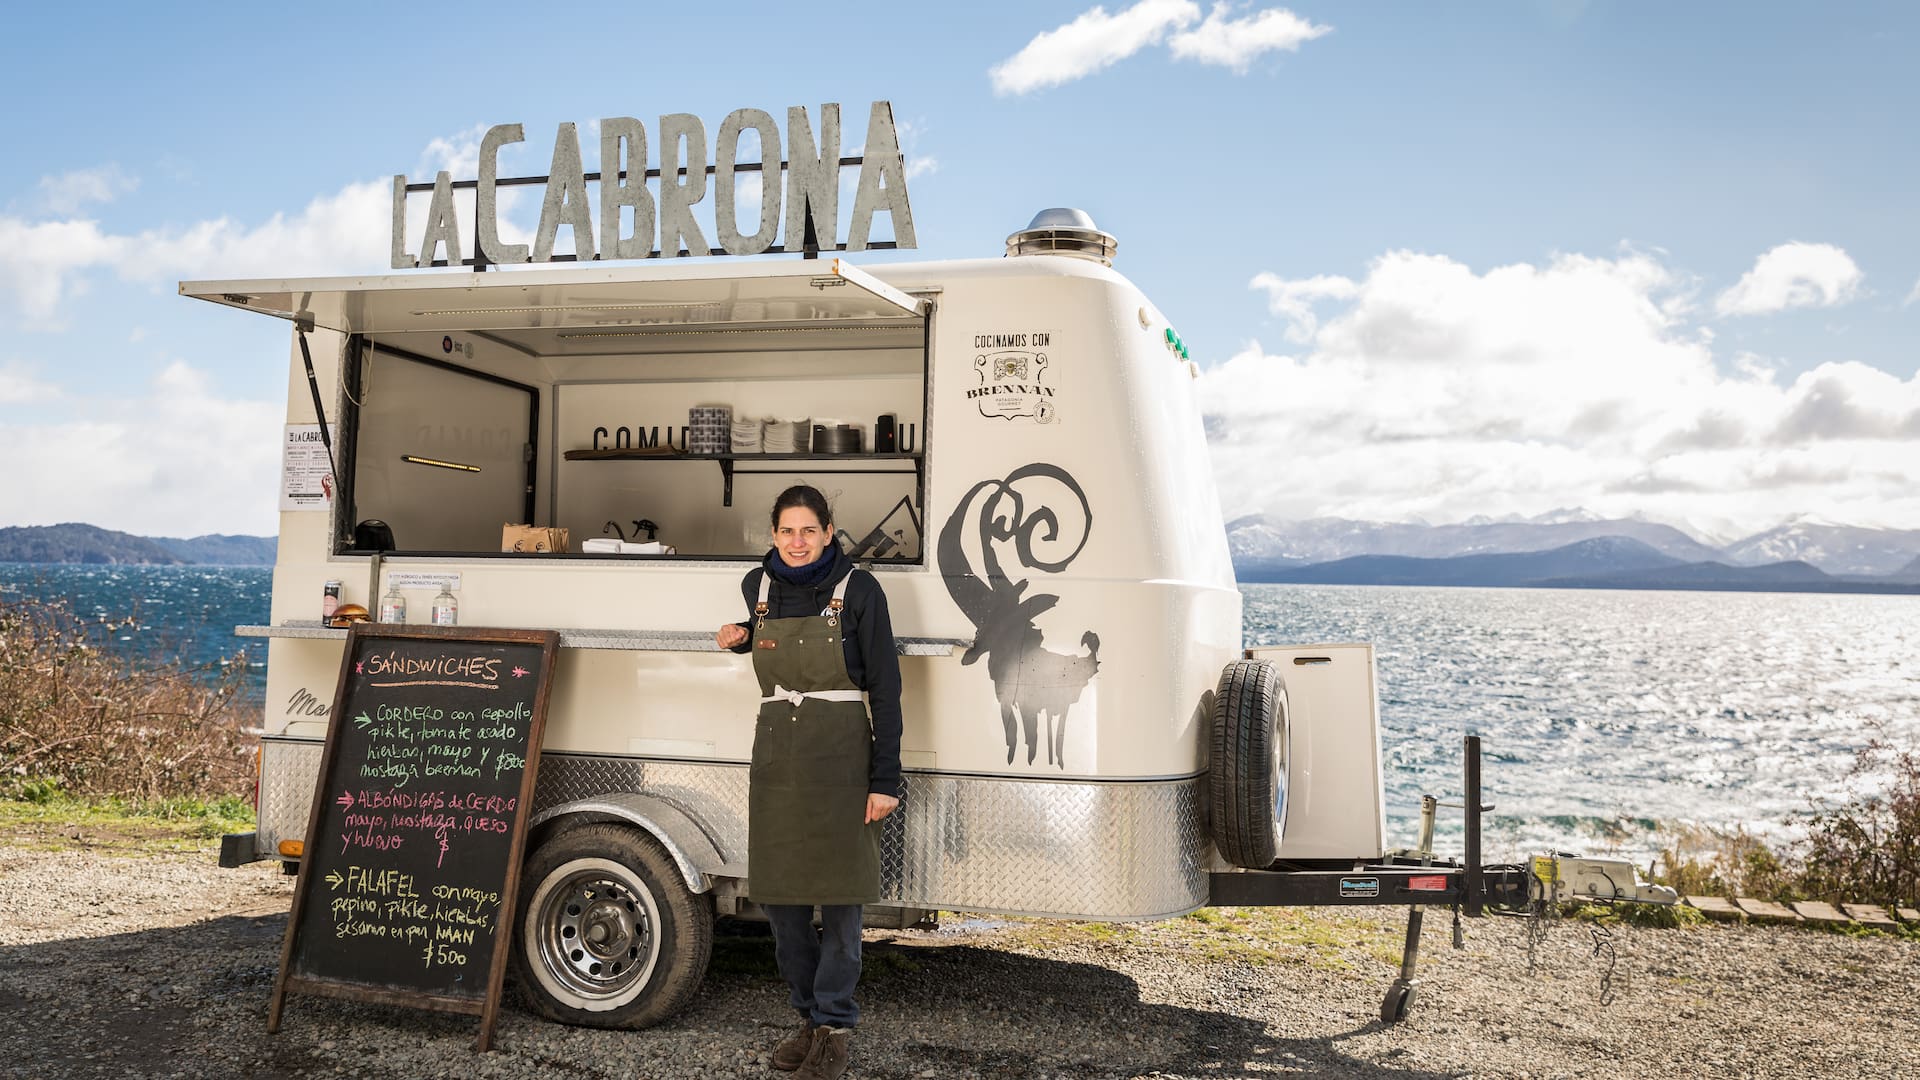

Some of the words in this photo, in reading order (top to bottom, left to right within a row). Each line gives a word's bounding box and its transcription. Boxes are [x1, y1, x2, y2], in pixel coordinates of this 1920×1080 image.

[391, 171, 461, 269] LA
[478, 100, 918, 265] CABRONA
[975, 334, 1027, 348] COCINAMOS
[1032, 333, 1050, 346] CON
[967, 385, 1056, 399] BRENNAN
[377, 703, 444, 721] CORDERO
[450, 711, 475, 721] con
[481, 747, 490, 765] y
[448, 795, 464, 810] de
[466, 793, 516, 814] CERDO
[347, 866, 419, 898] FALAFEL
[391, 926, 403, 938] en
[422, 939, 467, 969] $500
